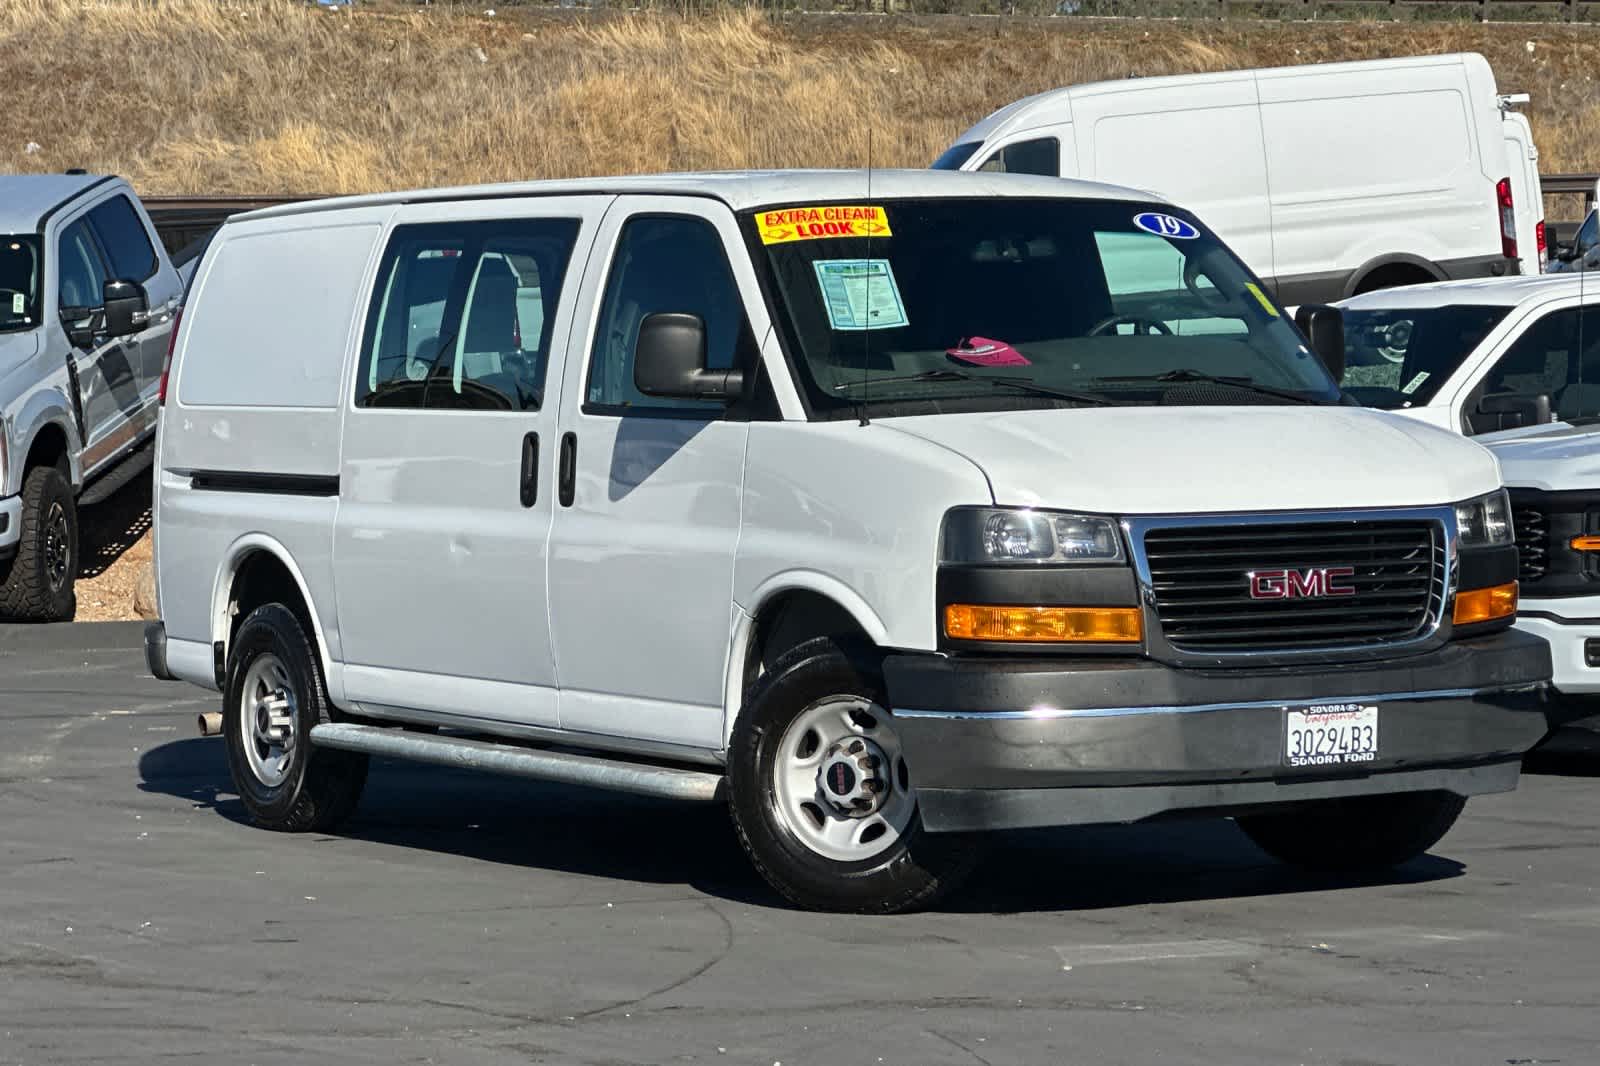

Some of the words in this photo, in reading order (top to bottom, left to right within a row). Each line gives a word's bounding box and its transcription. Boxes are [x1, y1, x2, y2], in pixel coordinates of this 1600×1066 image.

[765, 209, 819, 227] EXTRA
[824, 207, 878, 221] CLEAN
[1154, 215, 1181, 235] 19
[796, 221, 855, 237] LOOK
[1247, 566, 1356, 599] GMC
[1310, 704, 1346, 714] SONORA
[1291, 725, 1373, 756] 30294B3
[1290, 754, 1341, 766] SONORA
[1344, 752, 1375, 763] FORD
